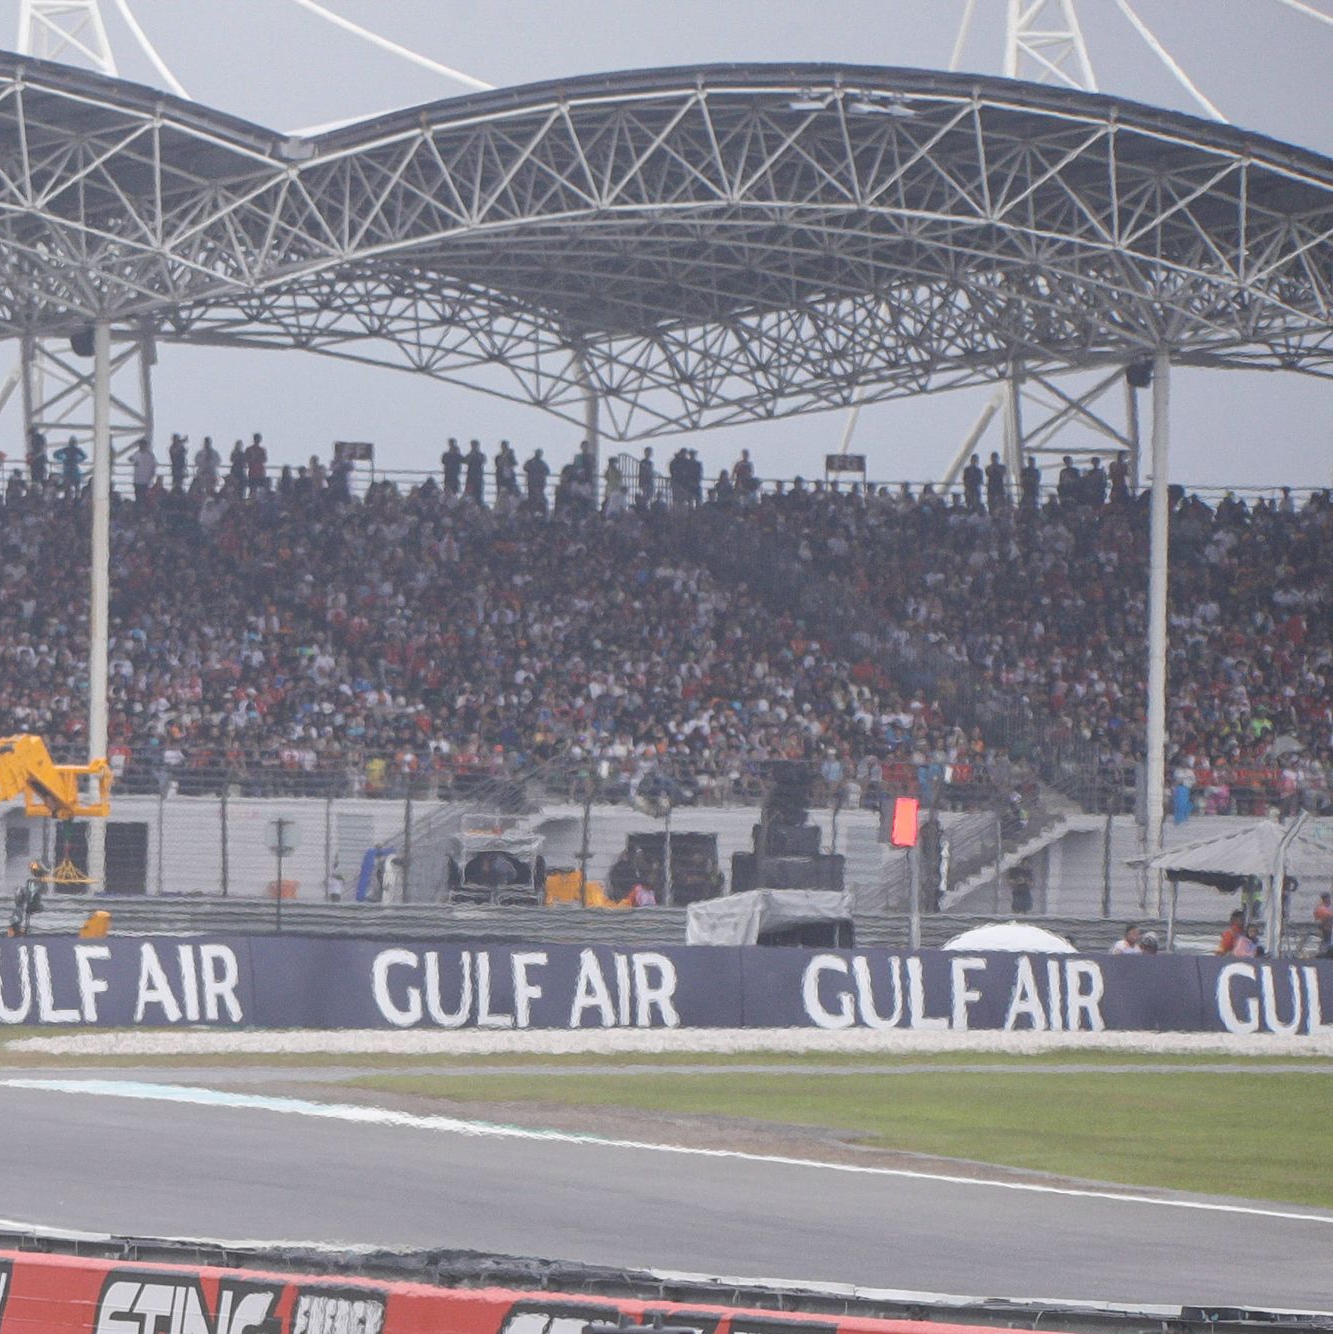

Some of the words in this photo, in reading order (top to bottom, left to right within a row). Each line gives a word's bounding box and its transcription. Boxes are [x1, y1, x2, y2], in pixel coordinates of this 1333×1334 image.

[134, 943, 243, 1022] AIR
[372, 949, 548, 1028] GULF
[569, 948, 681, 1028] AIR
[801, 955, 987, 1030] GULF
[1004, 955, 1104, 1032] AIR
[1216, 962, 1333, 1035] GUL
